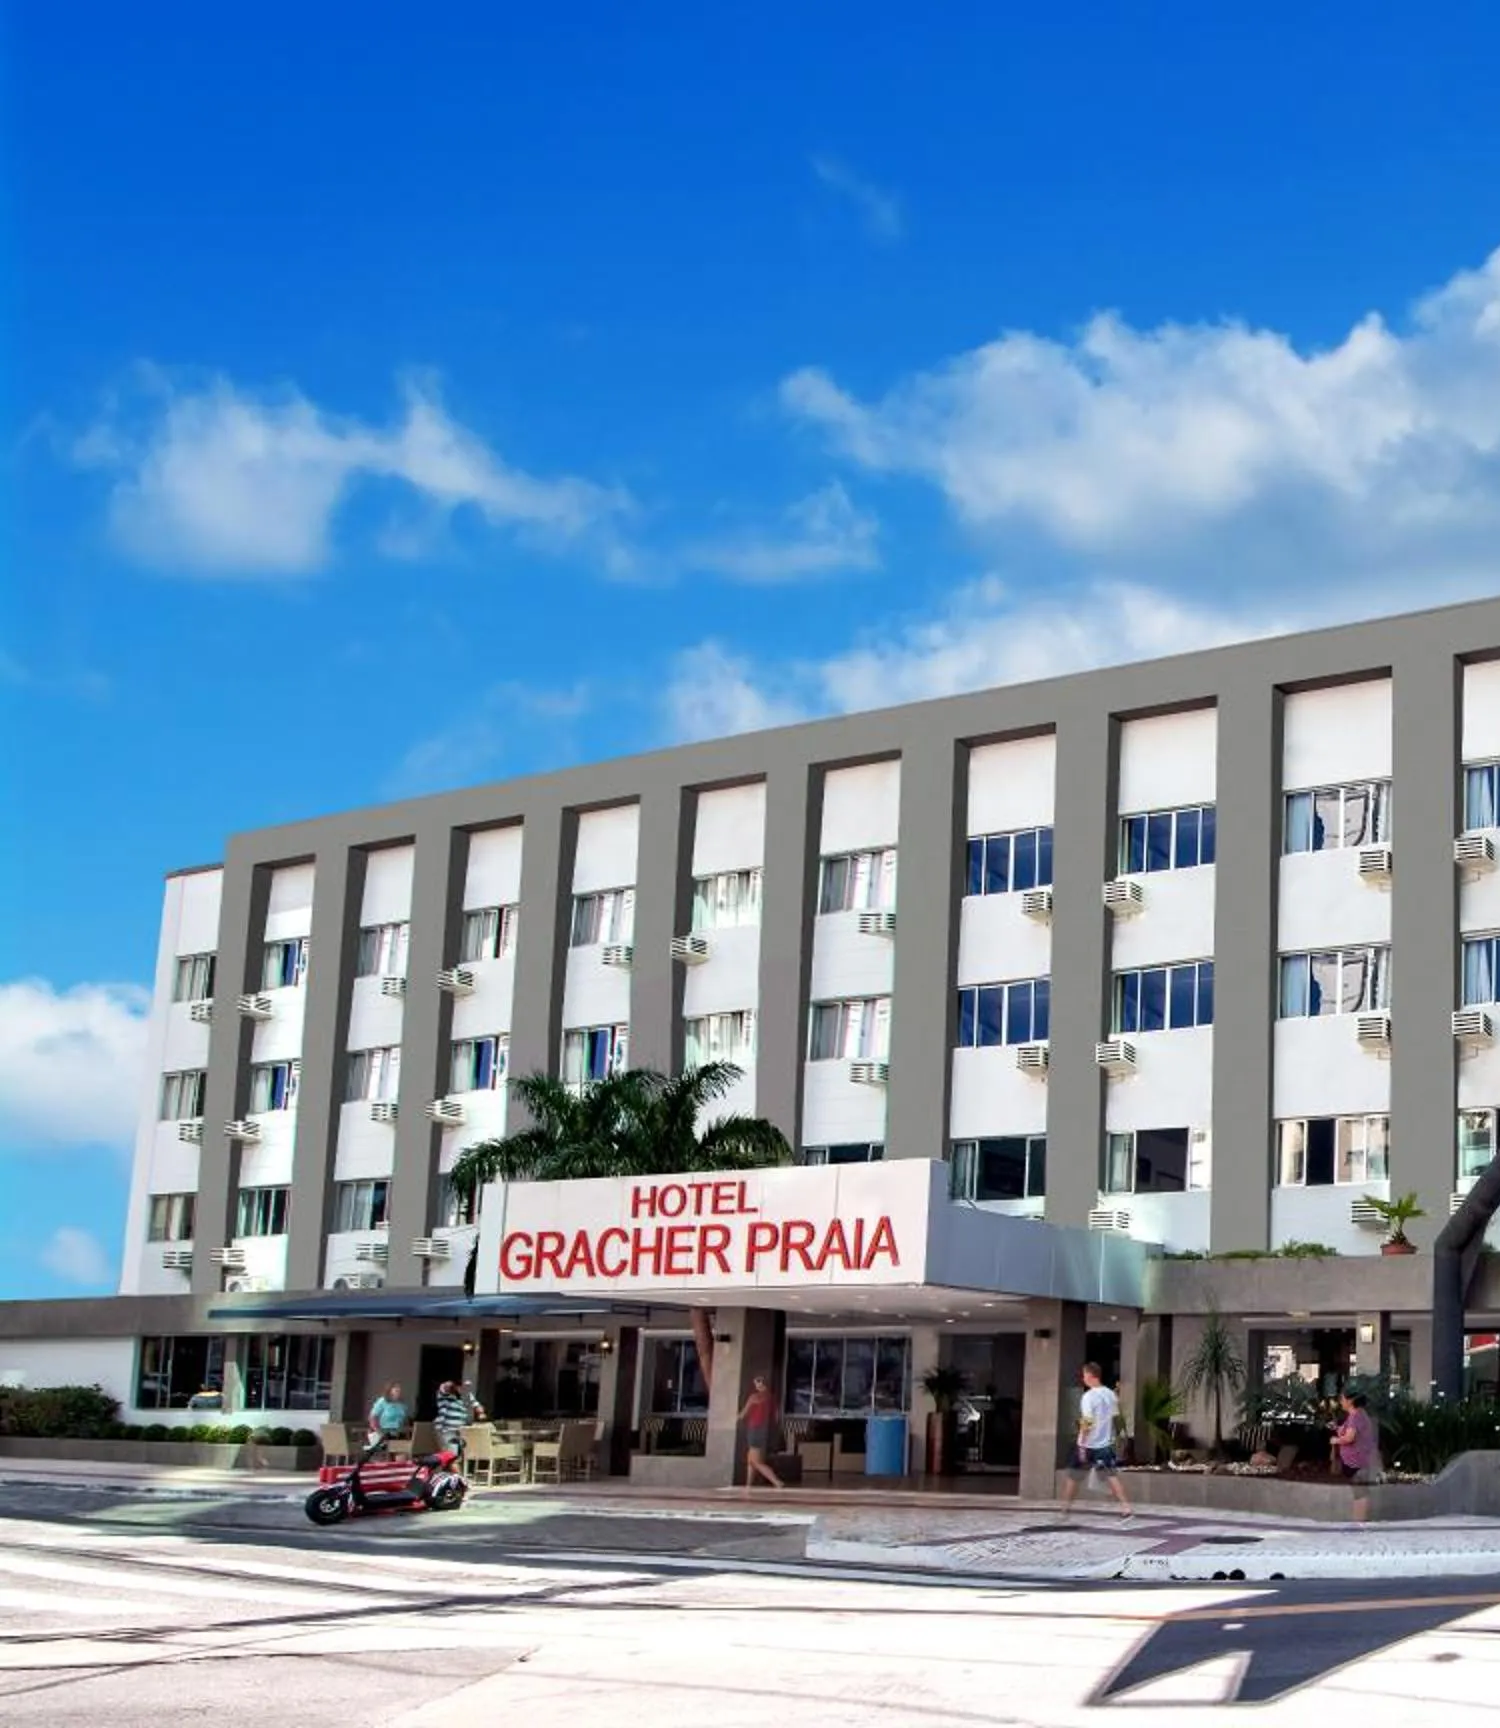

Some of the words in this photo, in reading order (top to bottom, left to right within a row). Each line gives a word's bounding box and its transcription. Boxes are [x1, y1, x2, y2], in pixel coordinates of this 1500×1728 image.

[631, 1181, 758, 1218] HOTEL
[499, 1224, 732, 1281] GRACHER
[745, 1215, 900, 1273] PRAIA
